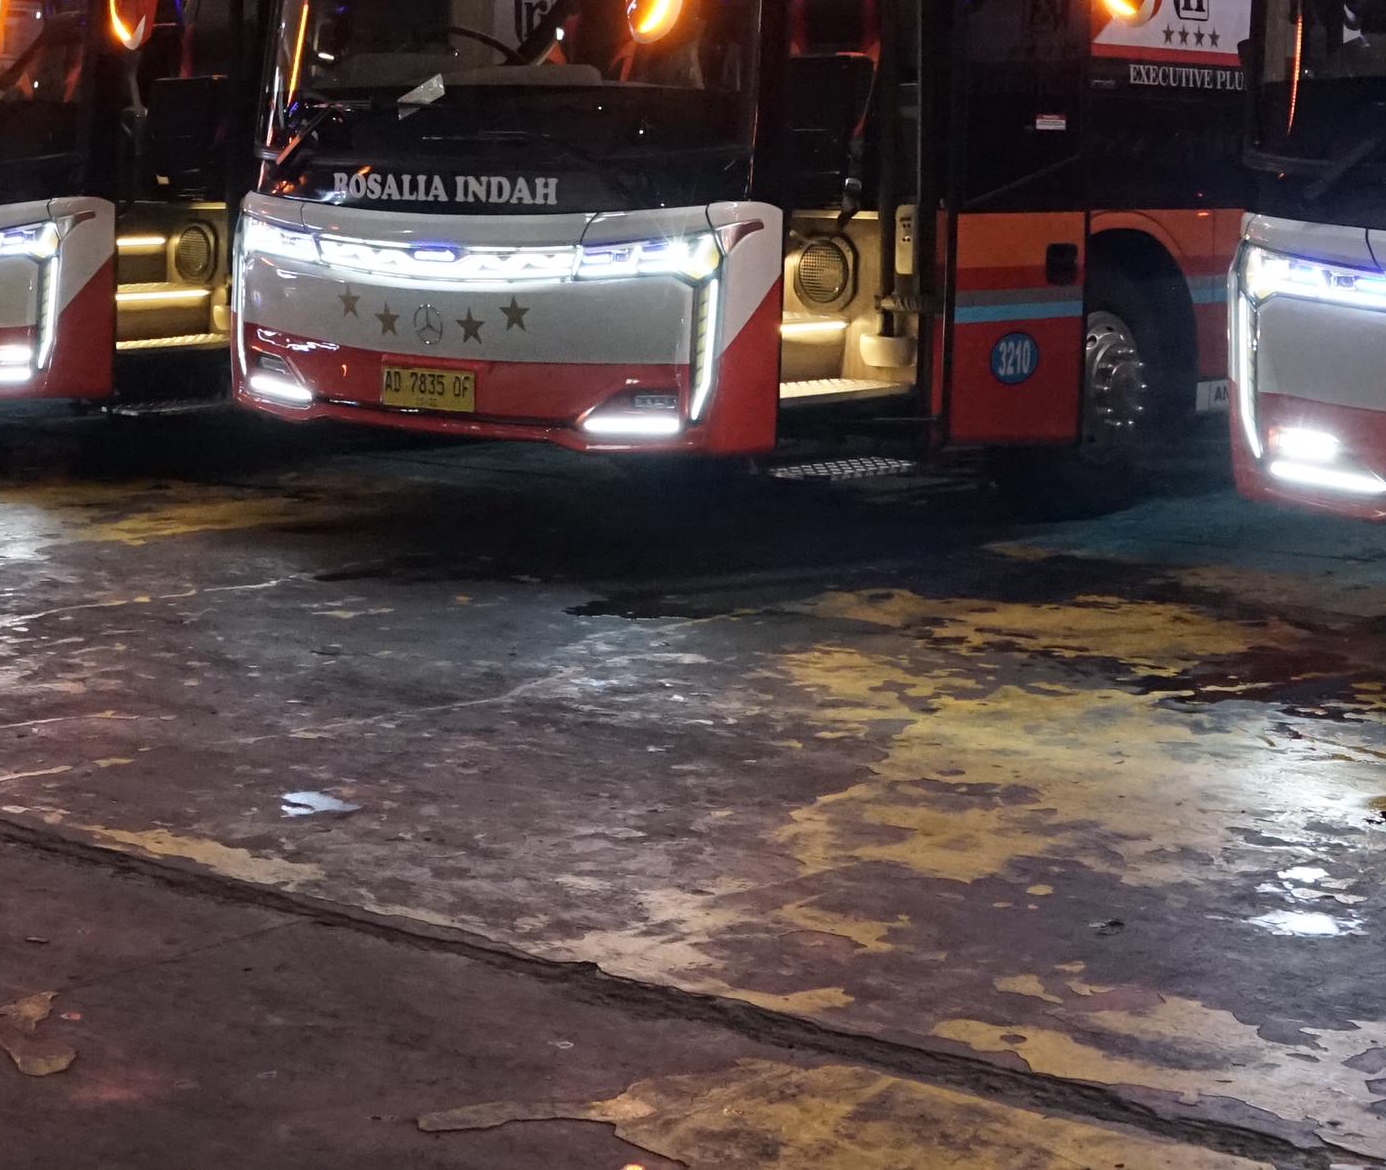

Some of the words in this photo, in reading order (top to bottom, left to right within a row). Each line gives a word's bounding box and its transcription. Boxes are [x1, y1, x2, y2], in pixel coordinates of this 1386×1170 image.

[1129, 64, 1213, 89] EXECUTIVE
[1216, 70, 1248, 91] PLU
[332, 172, 449, 202] ROSALIA
[454, 175, 559, 205] INDAH
[999, 340, 1031, 376] 3210
[385, 370, 402, 392] AD
[410, 372, 445, 396] 7835
[453, 376, 470, 398] OF
